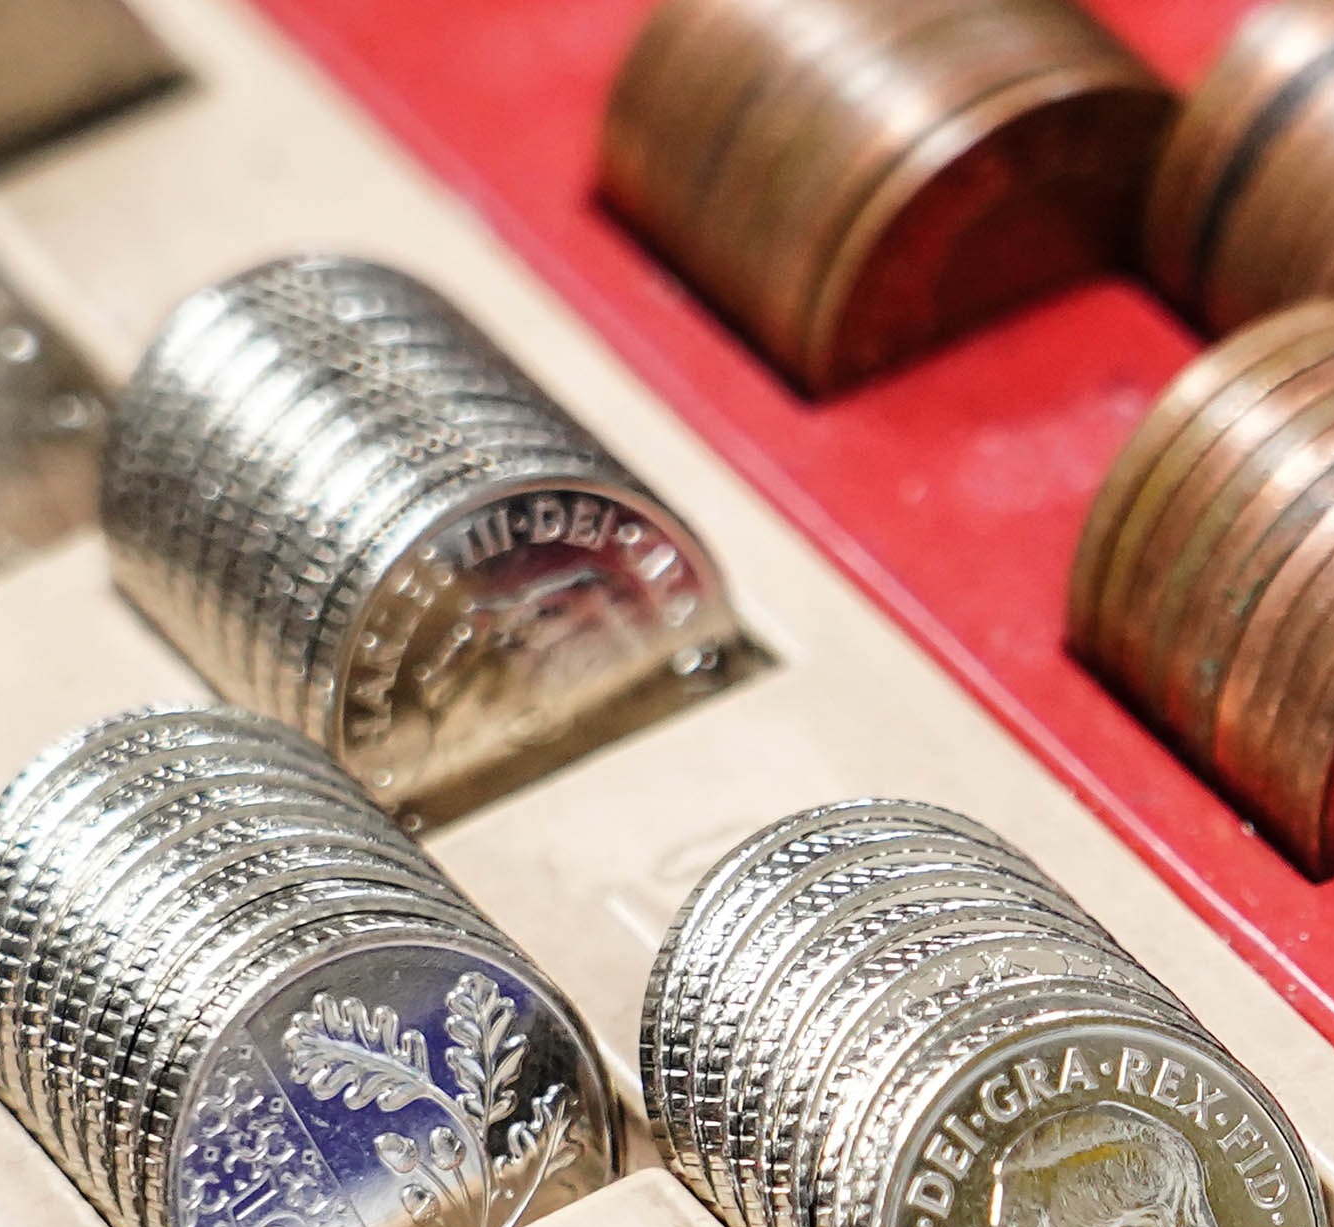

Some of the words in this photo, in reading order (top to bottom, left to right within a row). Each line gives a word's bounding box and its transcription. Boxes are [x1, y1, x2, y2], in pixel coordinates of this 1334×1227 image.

[906, 1114, 989, 1219] DEI
[979, 1046, 1101, 1125] GRA
[1116, 1046, 1226, 1131] REX
[1216, 1114, 1292, 1212] FID
